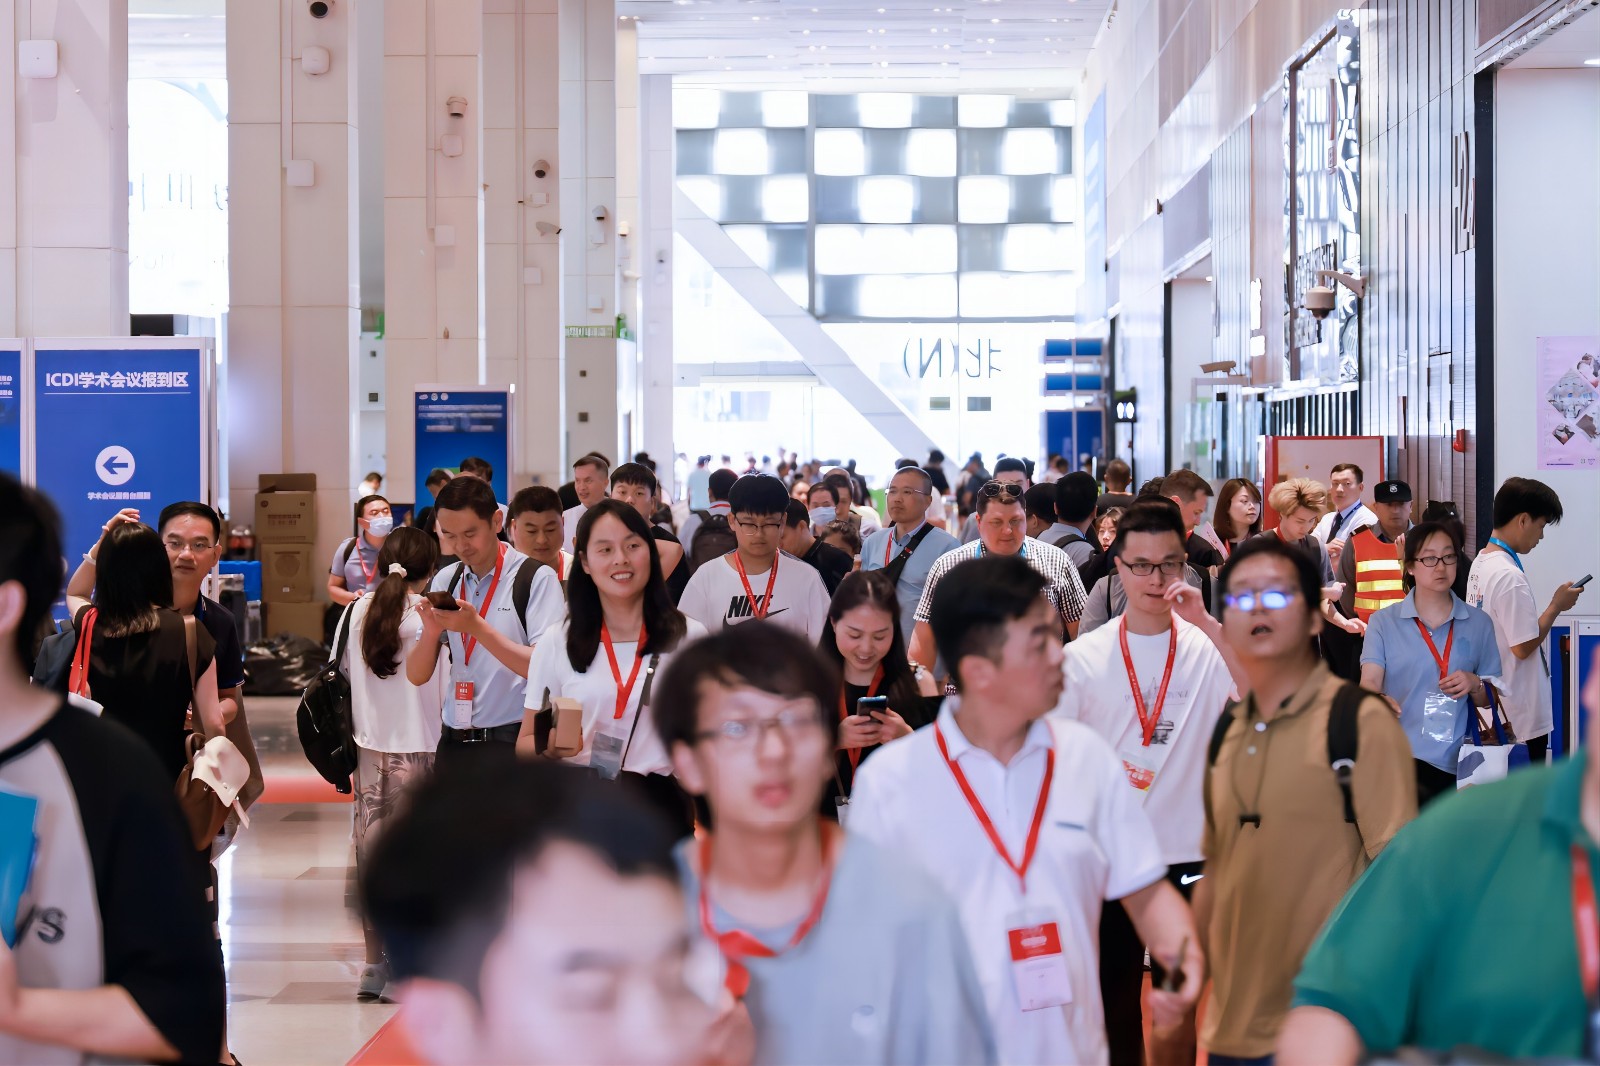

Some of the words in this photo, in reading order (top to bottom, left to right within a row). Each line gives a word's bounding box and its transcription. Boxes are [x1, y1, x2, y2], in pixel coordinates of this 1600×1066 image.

[45, 371, 189, 388] ICDI学术会议报到区
